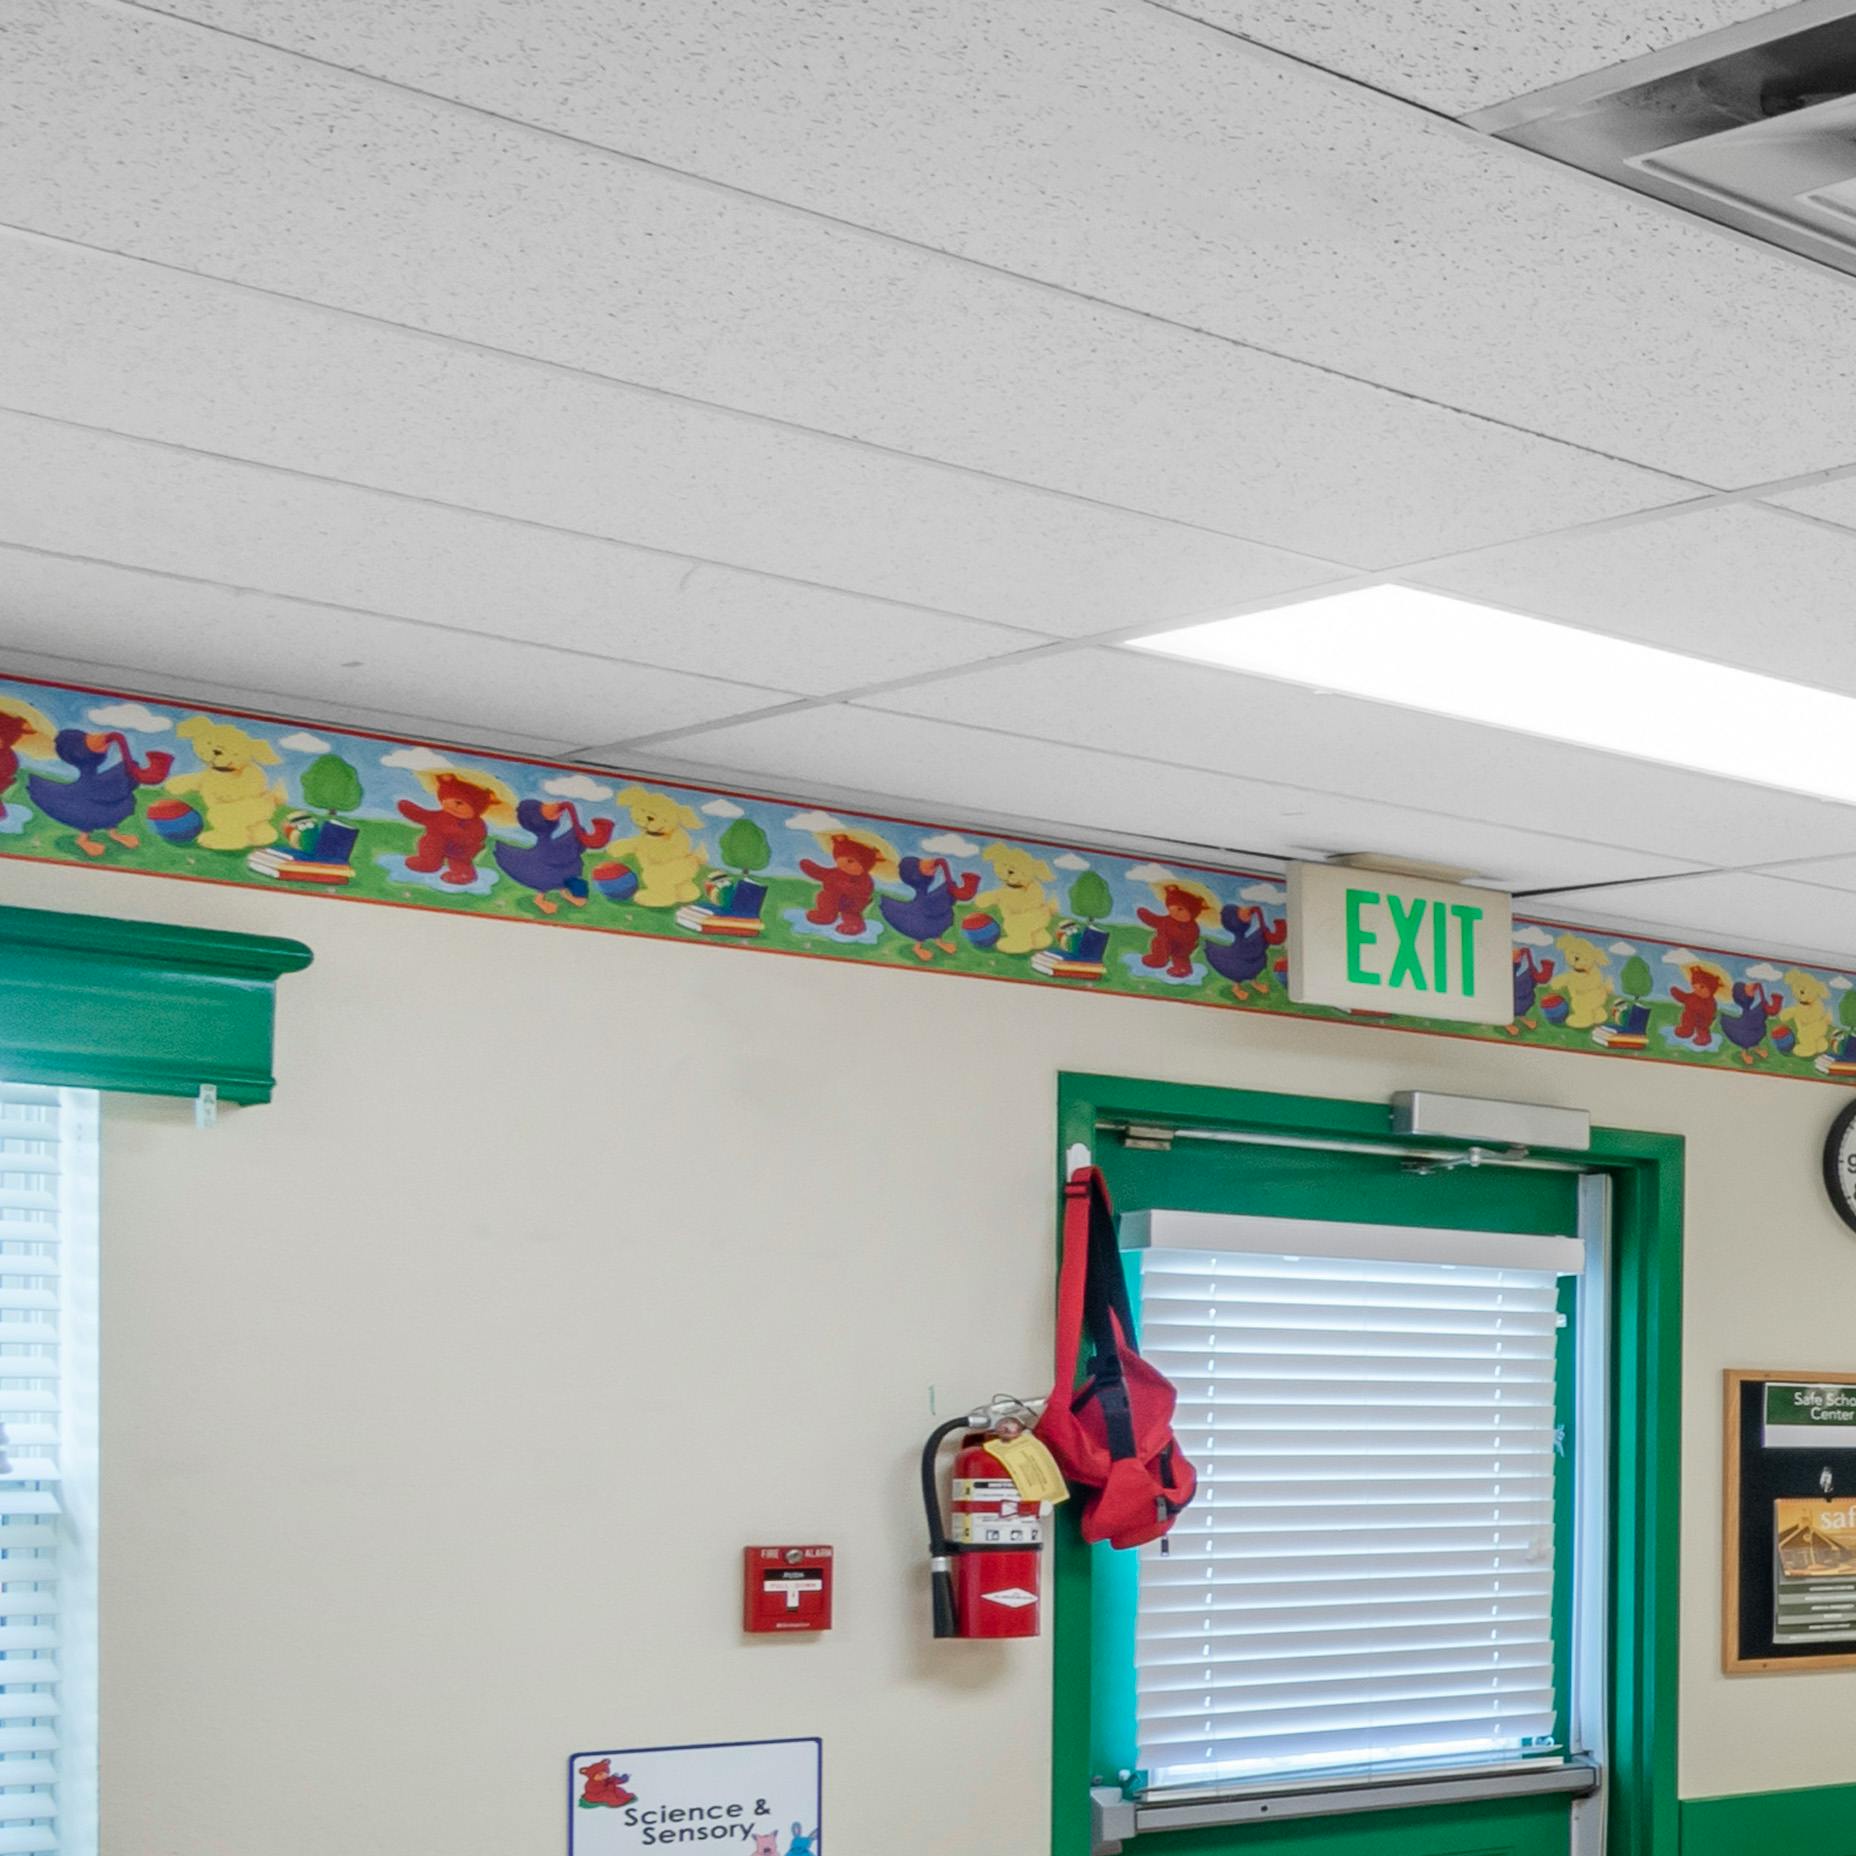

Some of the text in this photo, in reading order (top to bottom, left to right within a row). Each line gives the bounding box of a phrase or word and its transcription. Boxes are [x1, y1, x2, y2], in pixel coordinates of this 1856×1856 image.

[1346, 888, 1483, 997] EXIT
[1793, 1391, 1824, 1406] Safe
[1810, 1406, 1855, 1421] Center
[761, 1547, 833, 1559] FIRE ALARM
[624, 1798, 771, 1827] Science &
[642, 1822, 755, 1846] Sensory
